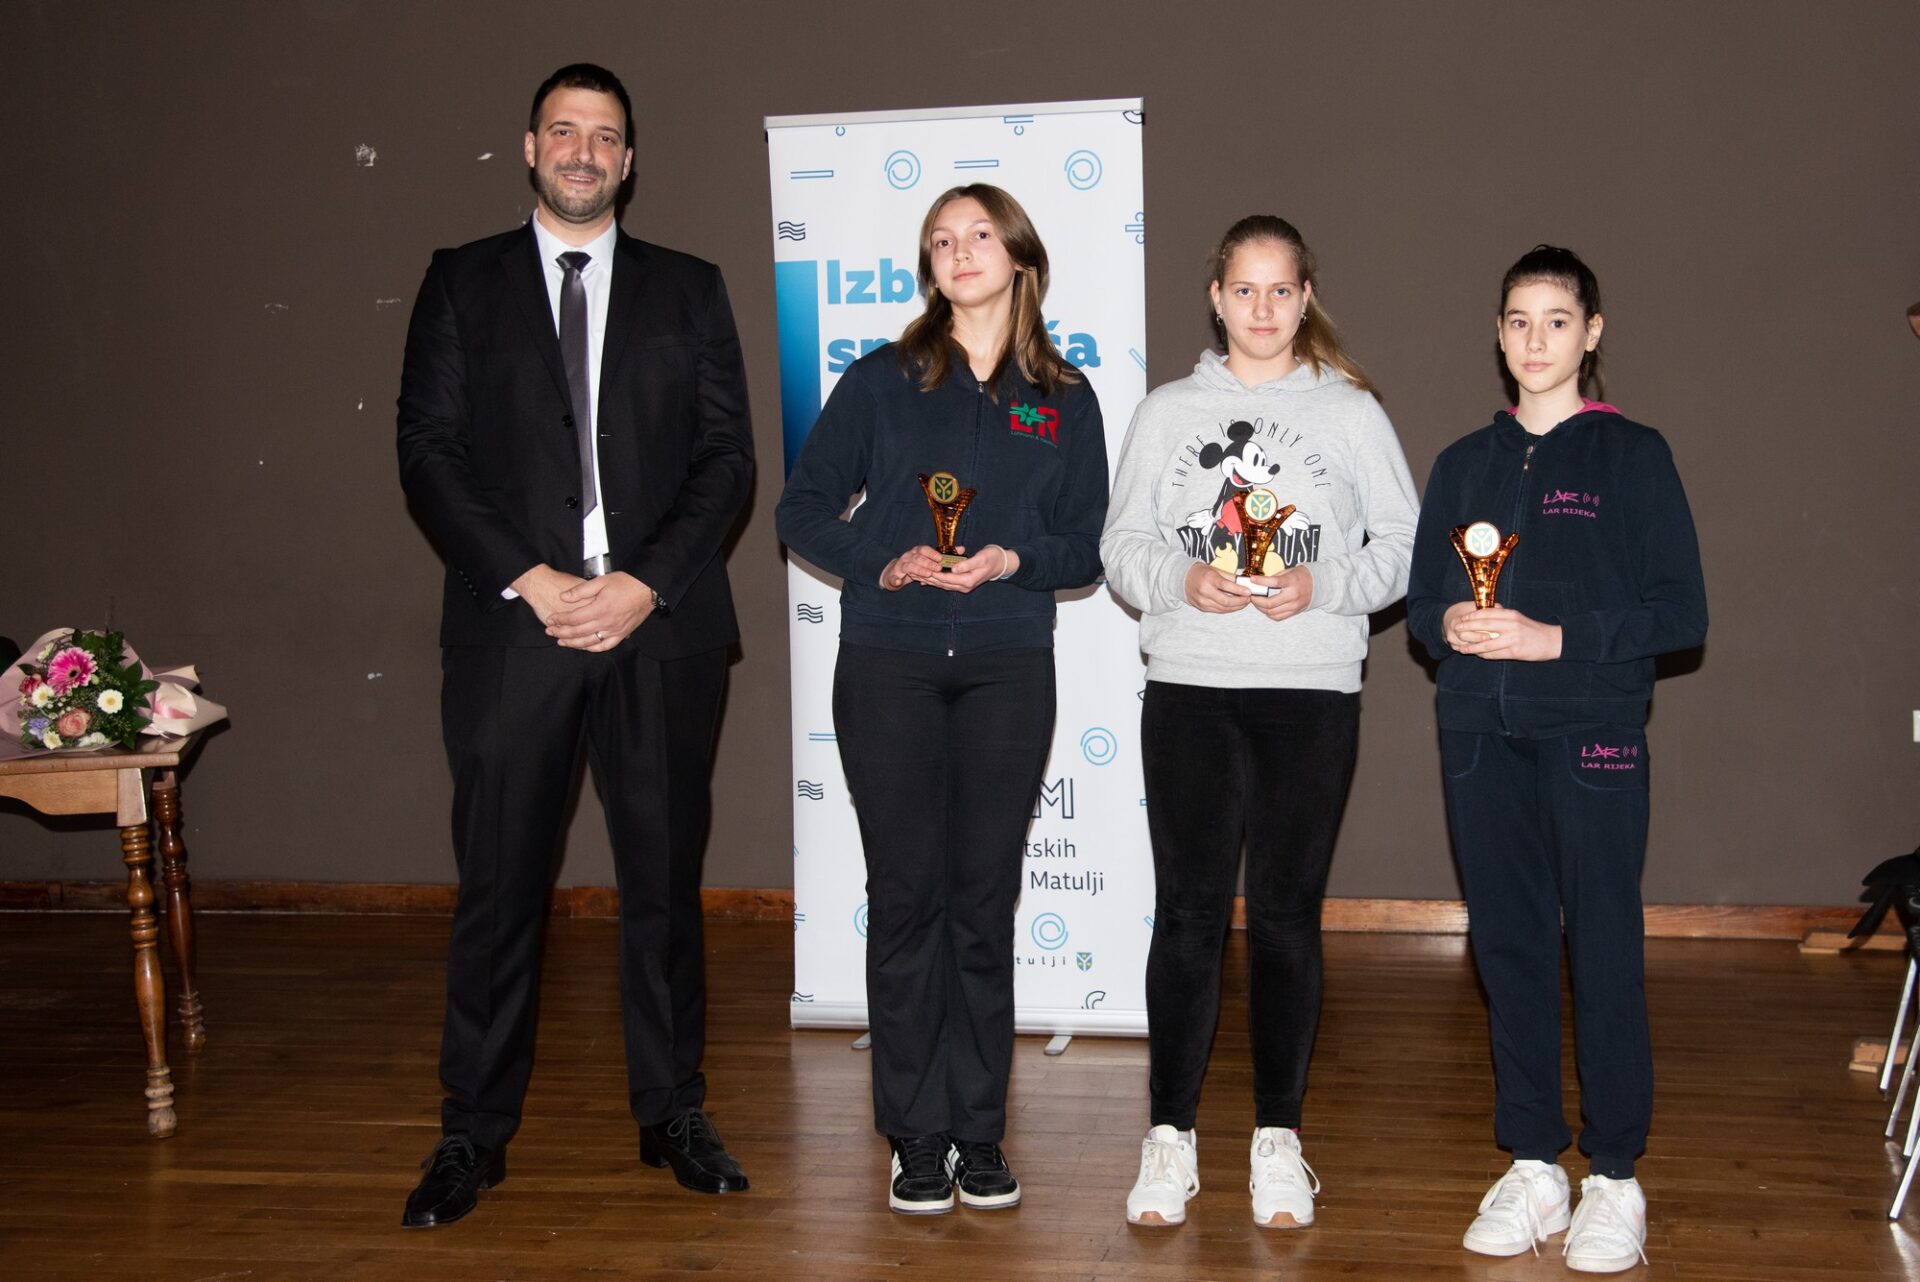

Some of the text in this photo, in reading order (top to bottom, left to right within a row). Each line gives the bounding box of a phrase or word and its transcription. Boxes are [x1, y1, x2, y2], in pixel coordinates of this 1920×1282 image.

[827, 258, 917, 305] Izb
[1253, 417, 1304, 448] ONLY
[1304, 453, 1332, 489] ONE
[1562, 508, 1597, 519] RIJEKA
[1603, 762, 1636, 770] RIJEKA
[1032, 778, 1074, 819] M
[1023, 838, 1076, 858] tskih
[1030, 870, 1104, 896] Matulji
[1015, 955, 1066, 968] tulji
